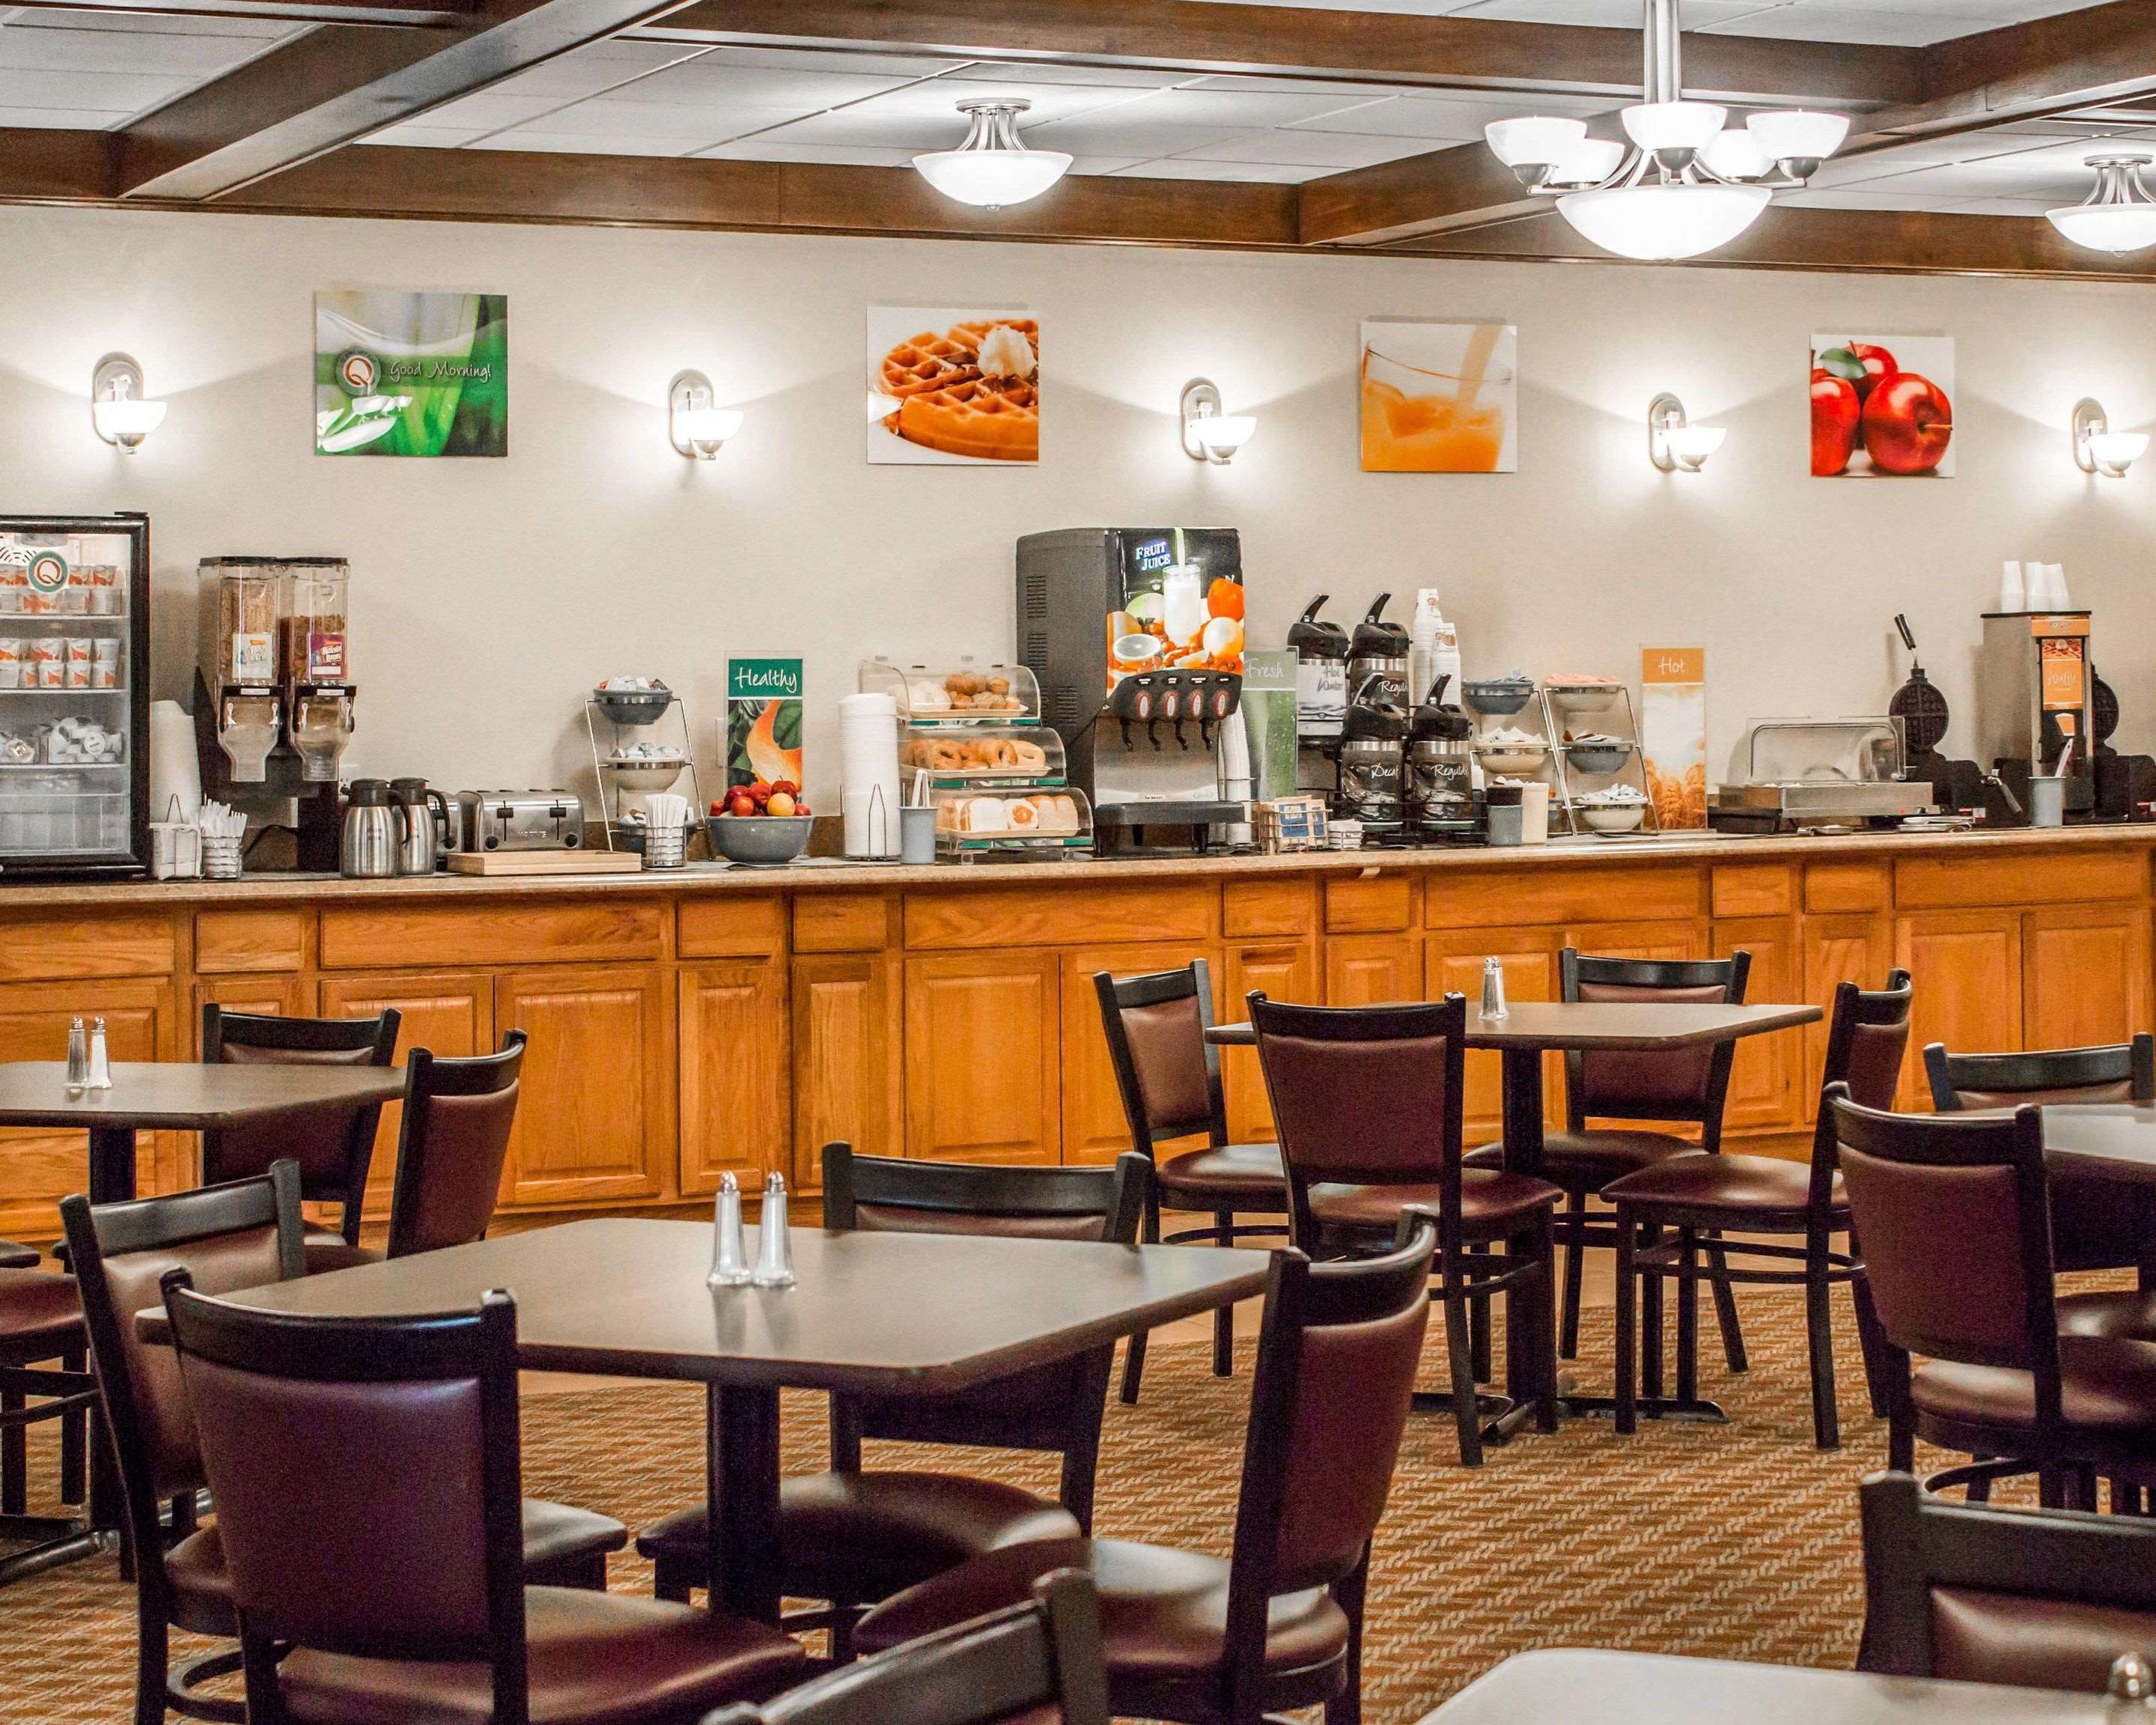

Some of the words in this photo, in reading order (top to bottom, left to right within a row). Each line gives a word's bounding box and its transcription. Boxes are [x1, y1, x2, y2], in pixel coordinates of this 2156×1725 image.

[344, 357, 375, 386] Q
[390, 359, 422, 383] Good
[427, 360, 492, 383] Morning!
[1135, 541, 1166, 560] FRUIT
[37, 560, 64, 584] Q
[1141, 554, 1172, 571] JUICE
[1244, 658, 1284, 678] Fresh
[1322, 661, 1340, 678] Hot
[1657, 655, 1685, 675] Hot
[734, 667, 797, 693] Healthy
[1317, 677, 1343, 693] Water
[1371, 762, 1399, 780] Decaf
[1430, 764, 1469, 780] Regular
